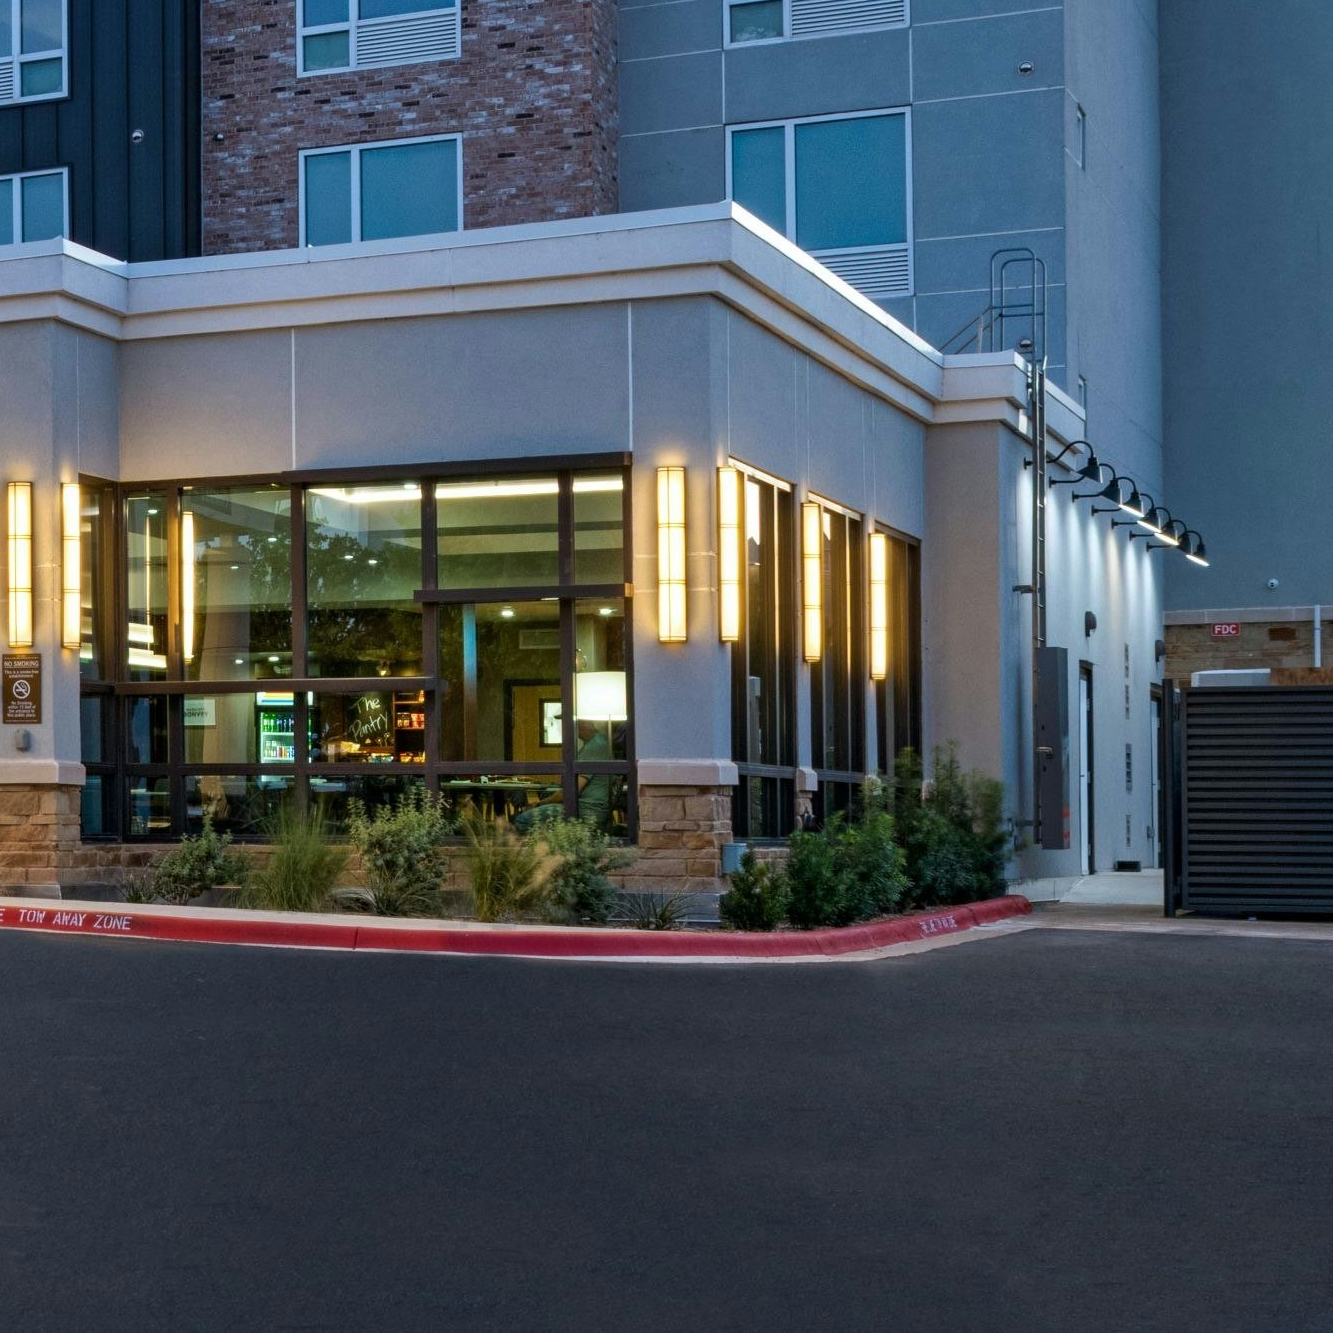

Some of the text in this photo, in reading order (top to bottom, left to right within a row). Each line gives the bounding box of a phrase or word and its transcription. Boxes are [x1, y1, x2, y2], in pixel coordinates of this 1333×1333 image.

[1214, 624, 1237, 634] FDC
[350, 696, 381, 714] The
[349, 711, 388, 742] Pantry
[19, 909, 46, 923] TOW
[52, 912, 87, 927] AWAY
[93, 914, 133, 930] ZONE
